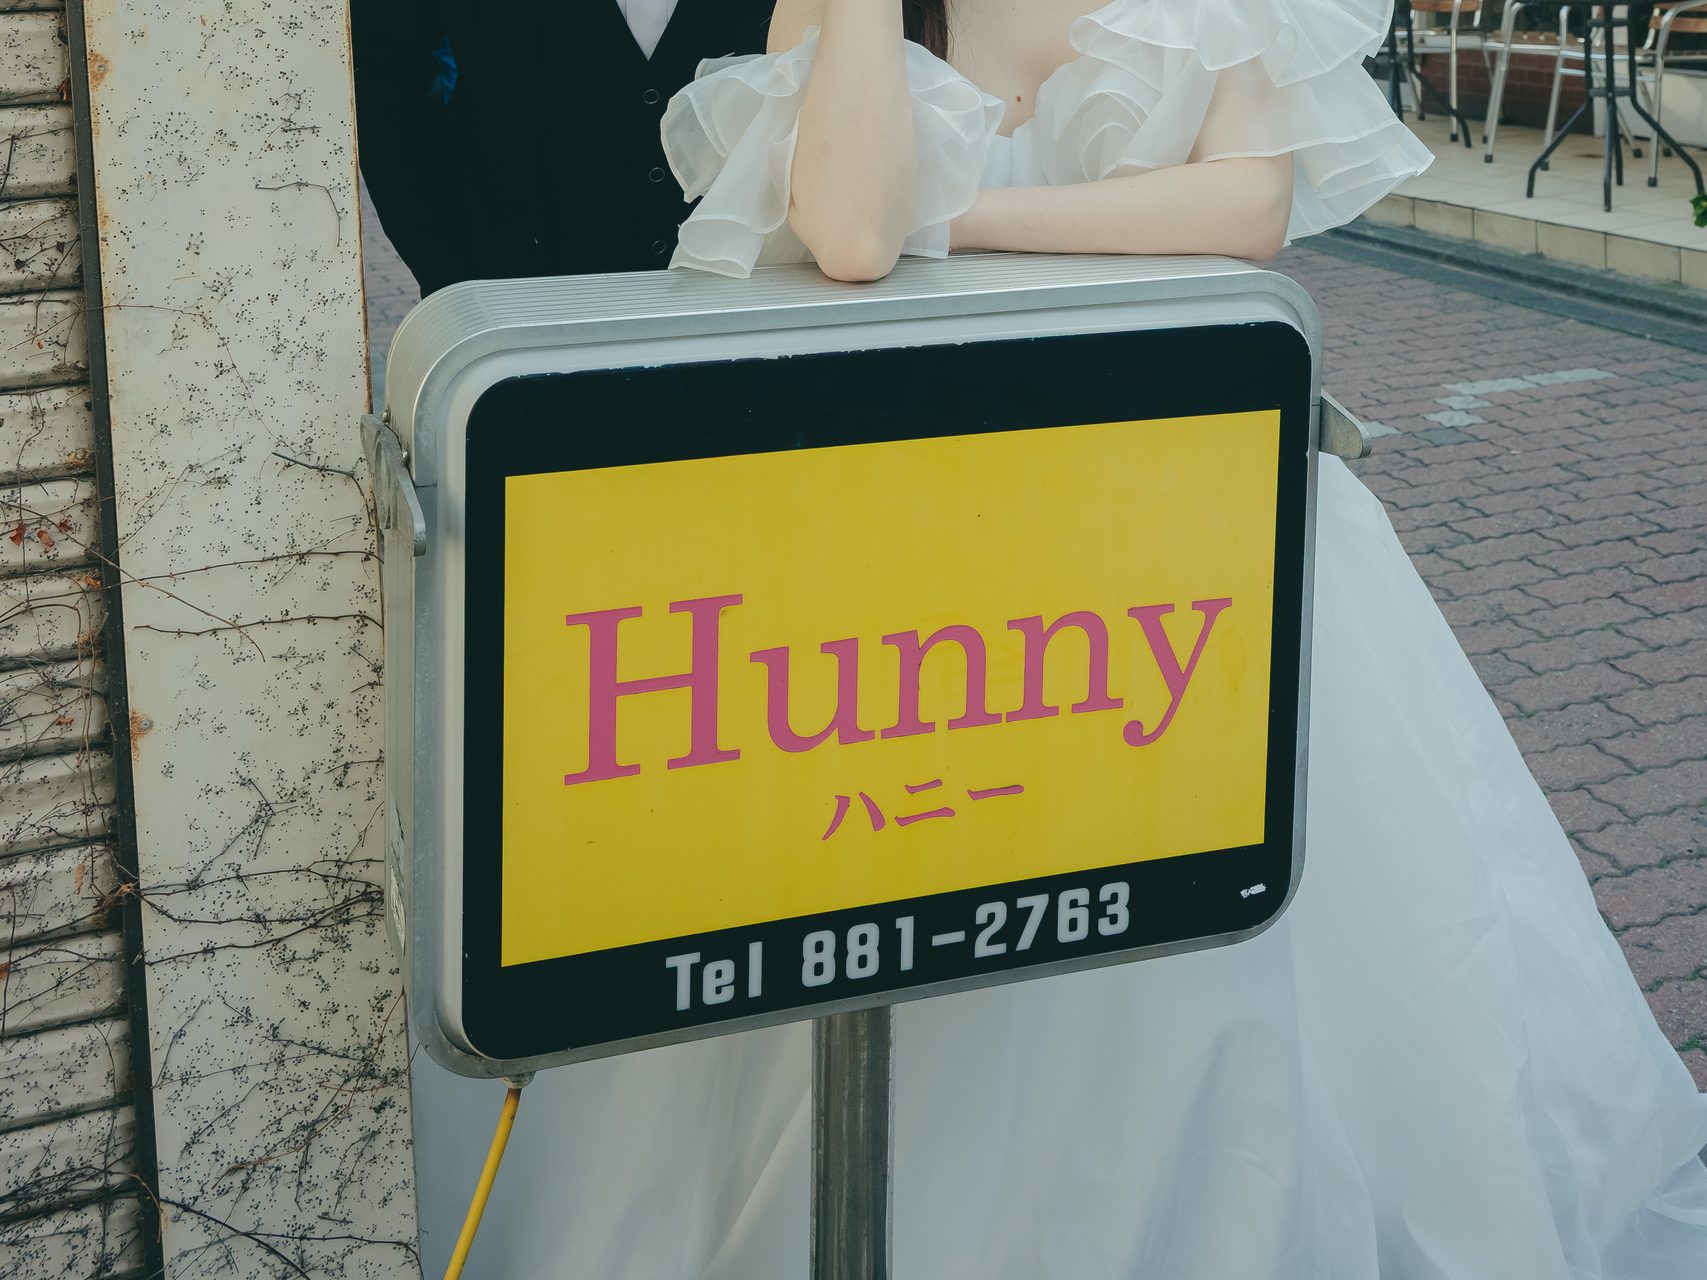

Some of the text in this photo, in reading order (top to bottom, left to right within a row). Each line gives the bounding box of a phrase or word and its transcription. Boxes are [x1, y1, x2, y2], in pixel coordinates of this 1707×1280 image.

[564, 594, 1232, 786] Hunny
[821, 778, 1025, 841] ハニー
[666, 882, 1130, 1011] Tel 881-2763
